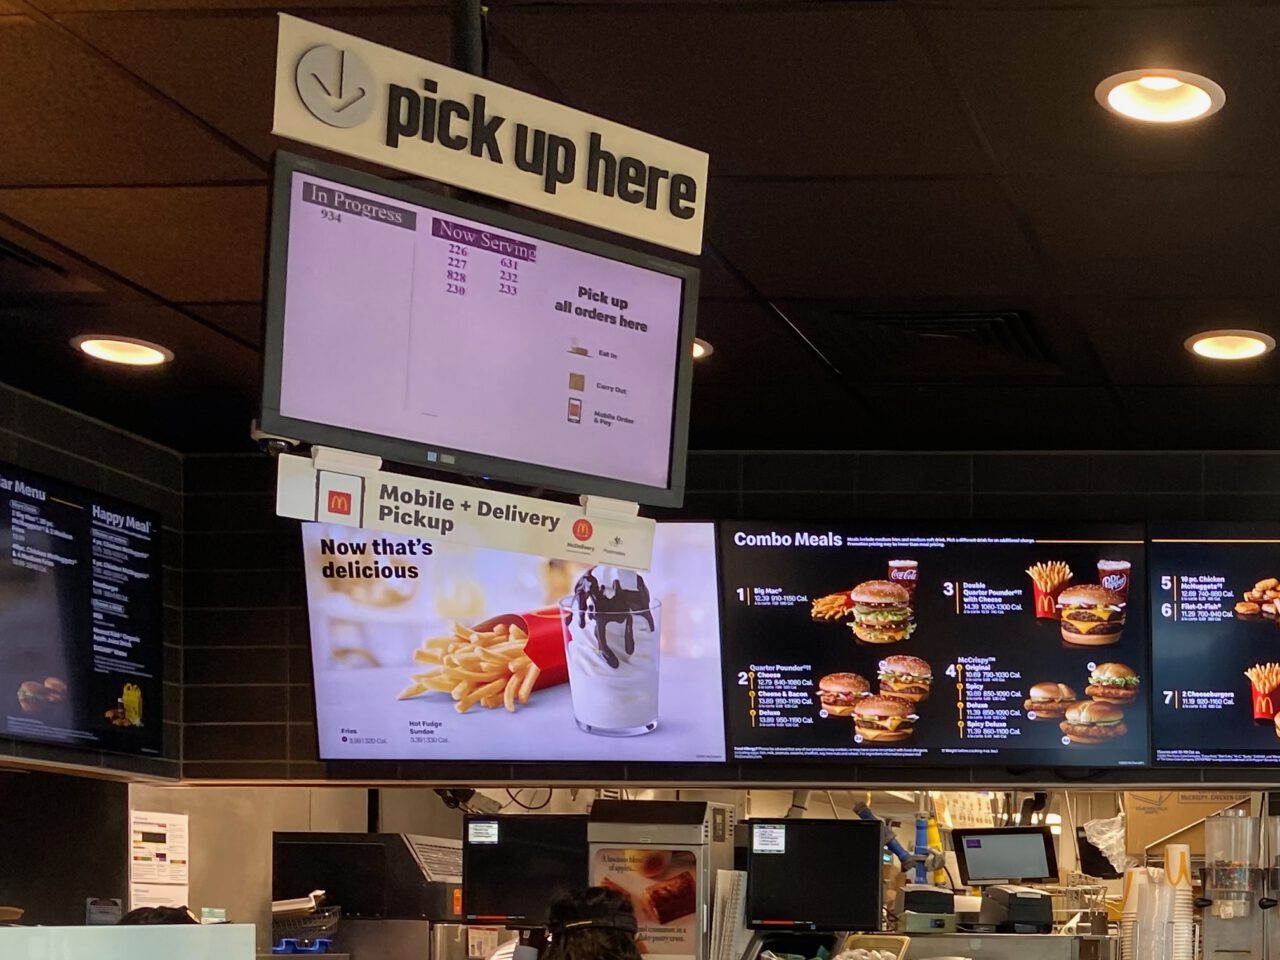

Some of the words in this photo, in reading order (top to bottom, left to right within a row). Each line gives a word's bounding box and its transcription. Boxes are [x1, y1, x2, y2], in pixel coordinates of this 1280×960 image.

[385, 79, 505, 164] pick
[514, 122, 577, 194] up
[586, 131, 697, 220] here
[311, 185, 328, 202] In
[334, 191, 402, 223] Progress
[321, 209, 342, 223] 934
[440, 222, 475, 243] Now
[481, 232, 536, 262] Serving
[449, 244, 468, 257] 226
[448, 257, 466, 269] 227
[501, 258, 518, 270] 631
[447, 270, 466, 283] 828
[500, 271, 518, 283] 232
[446, 283, 465, 296] 230
[499, 283, 517, 295] 233
[578, 286, 608, 304] Pick
[611, 296, 628, 310] up
[555, 300, 571, 313] all
[575, 307, 616, 325] orders
[620, 315, 648, 332] here
[599, 350, 609, 358] Eat
[597, 382, 614, 392] Carry
[615, 386, 626, 394] Out
[15, 480, 46, 500] Menu
[379, 484, 454, 511] Mobile
[461, 500, 471, 511] +
[477, 501, 560, 531] Delivery
[92, 505, 124, 527] Happy
[379, 503, 454, 535] Pickup
[734, 531, 792, 546] Combo
[795, 531, 842, 546] Meals
[320, 539, 366, 555] Now
[371, 539, 433, 555] that's
[322, 561, 419, 579] delicious
[943, 582, 954, 596] 3
[1161, 576, 1171, 590] 5
[736, 588, 744, 601] 1
[1161, 603, 1172, 617] 6
[945, 664, 956, 677] 4
[738, 672, 748, 685] 2
[966, 683, 984, 691] Spicy
[1163, 691, 1173, 704] 7
[422, 721, 442, 729] Fudge
